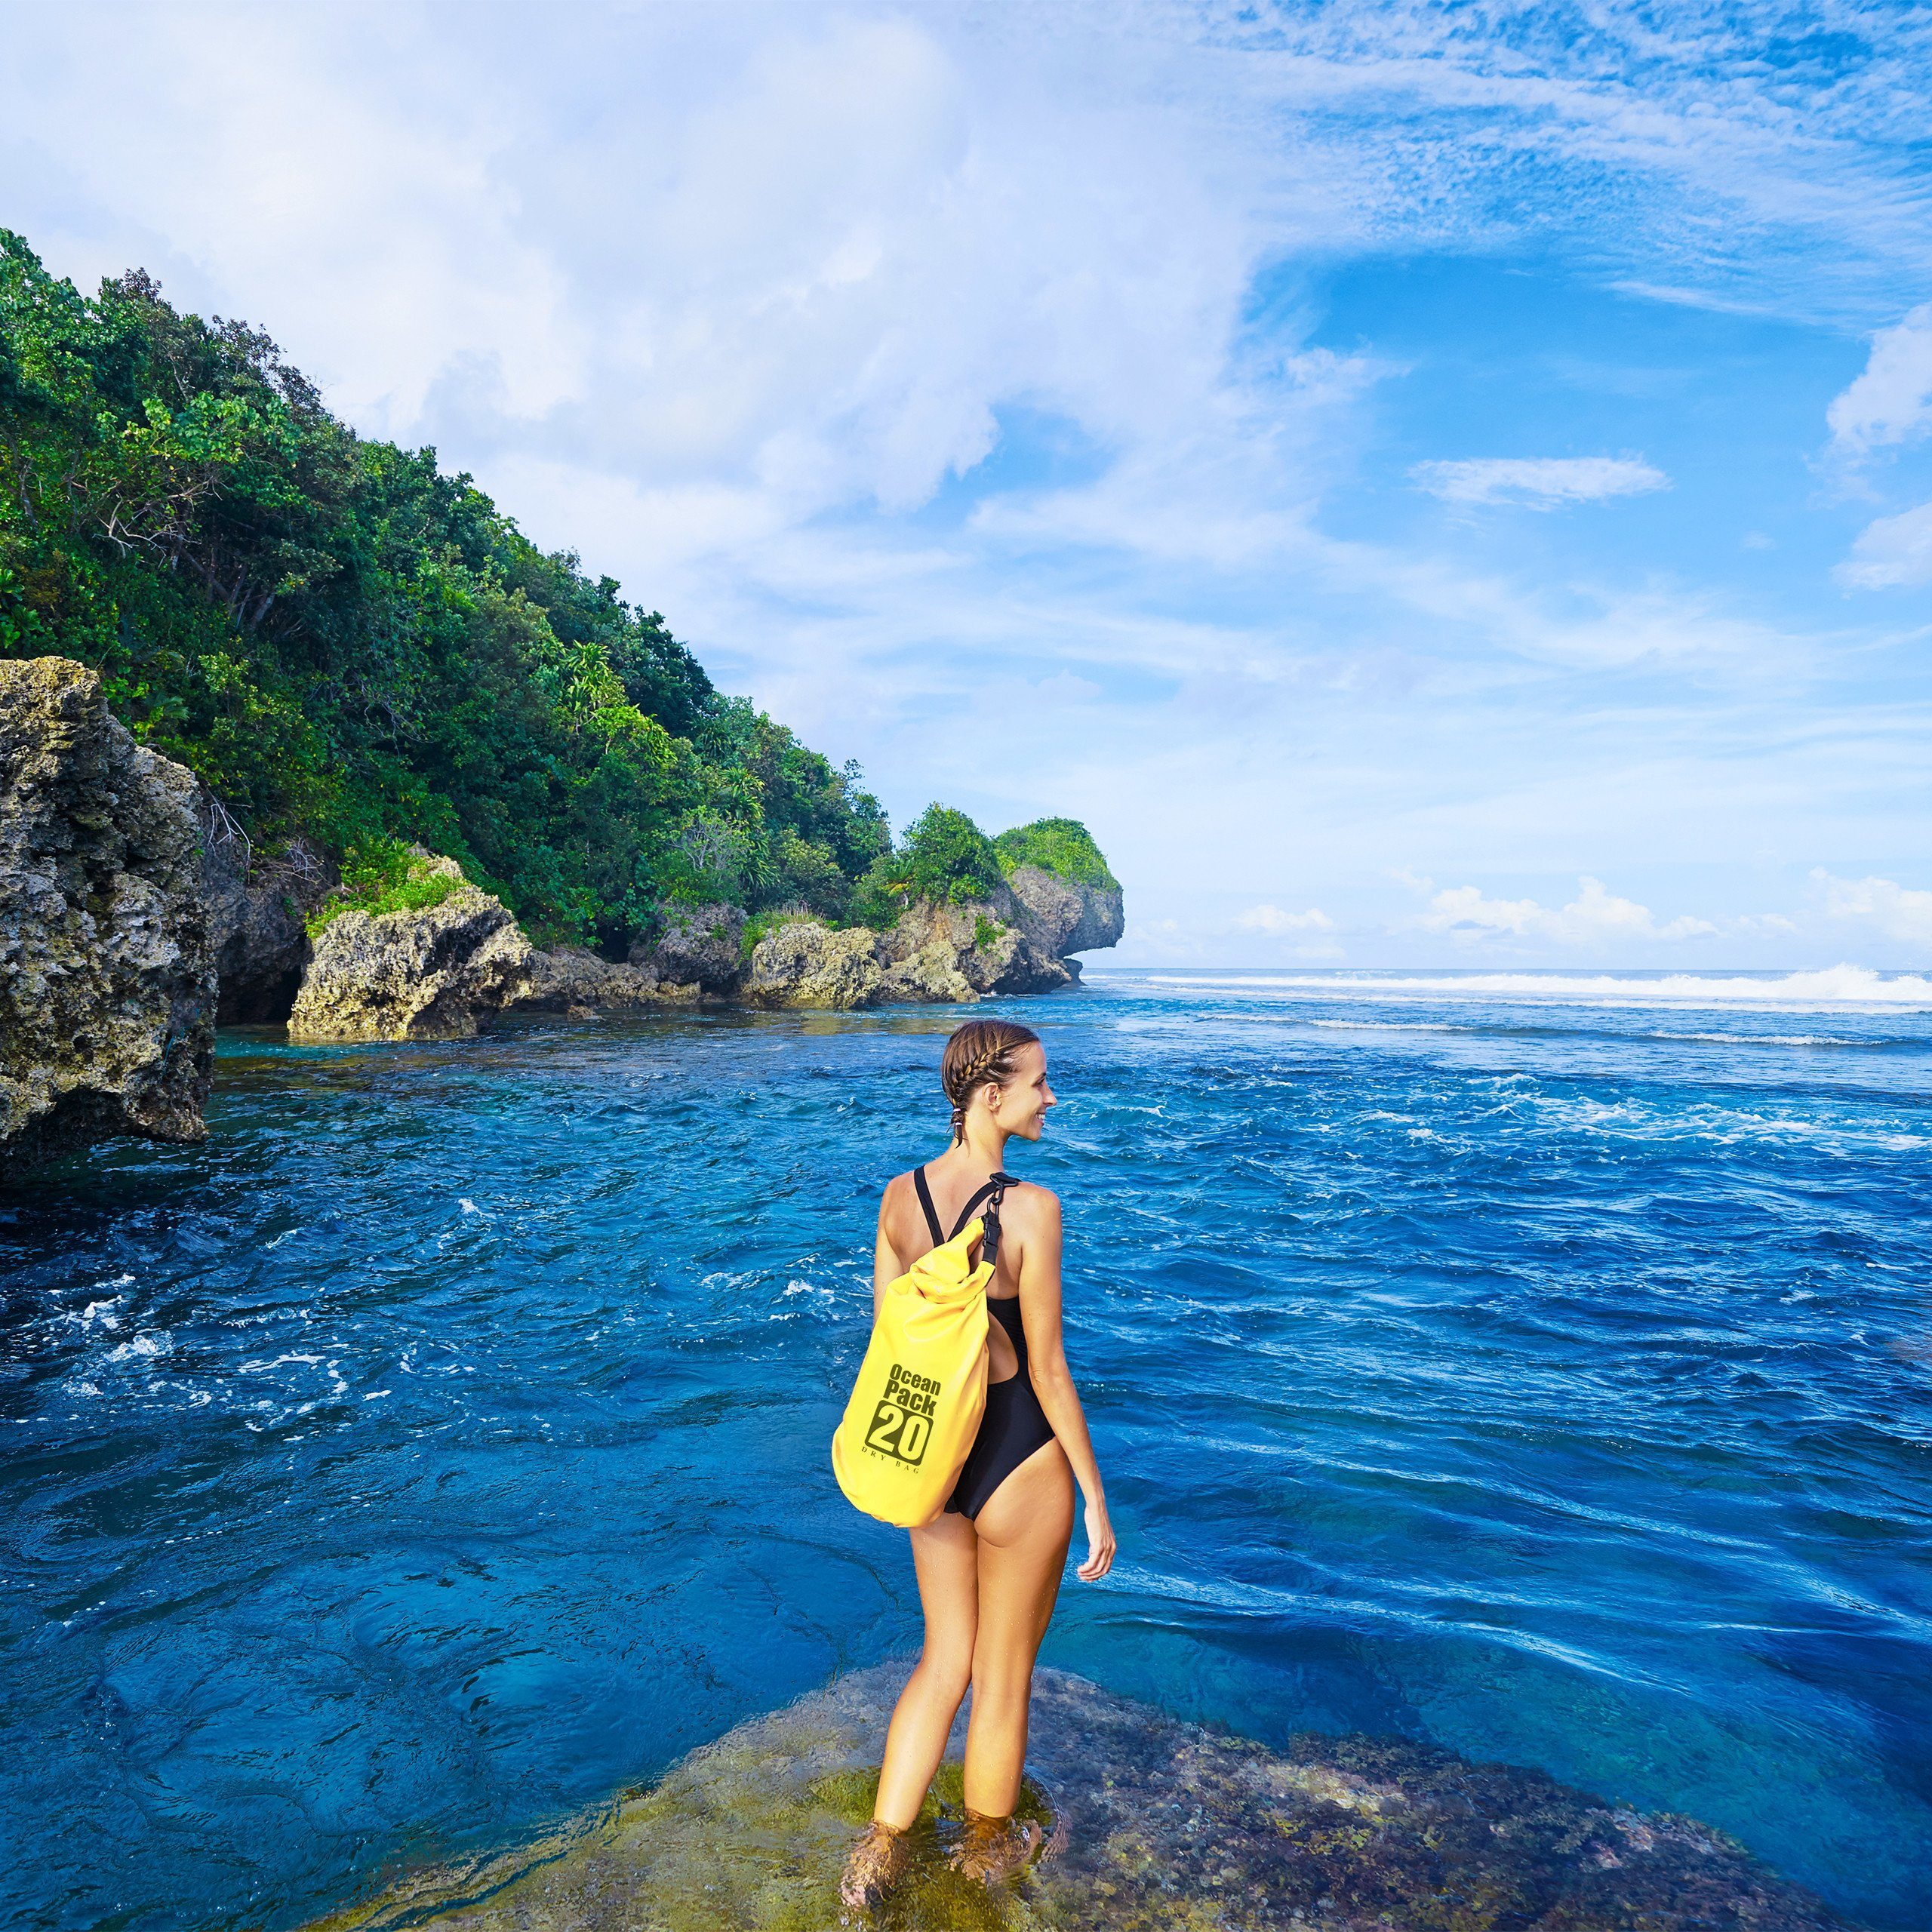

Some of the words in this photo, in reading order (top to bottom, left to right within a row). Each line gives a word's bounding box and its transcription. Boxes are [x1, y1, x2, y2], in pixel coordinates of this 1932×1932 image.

[890, 1364, 941, 1396] Ocean
[883, 1379, 937, 1417] Pack
[868, 1404, 929, 1460] 20
[861, 1447, 886, 1460] DRY
[896, 1461, 919, 1474] BAG
